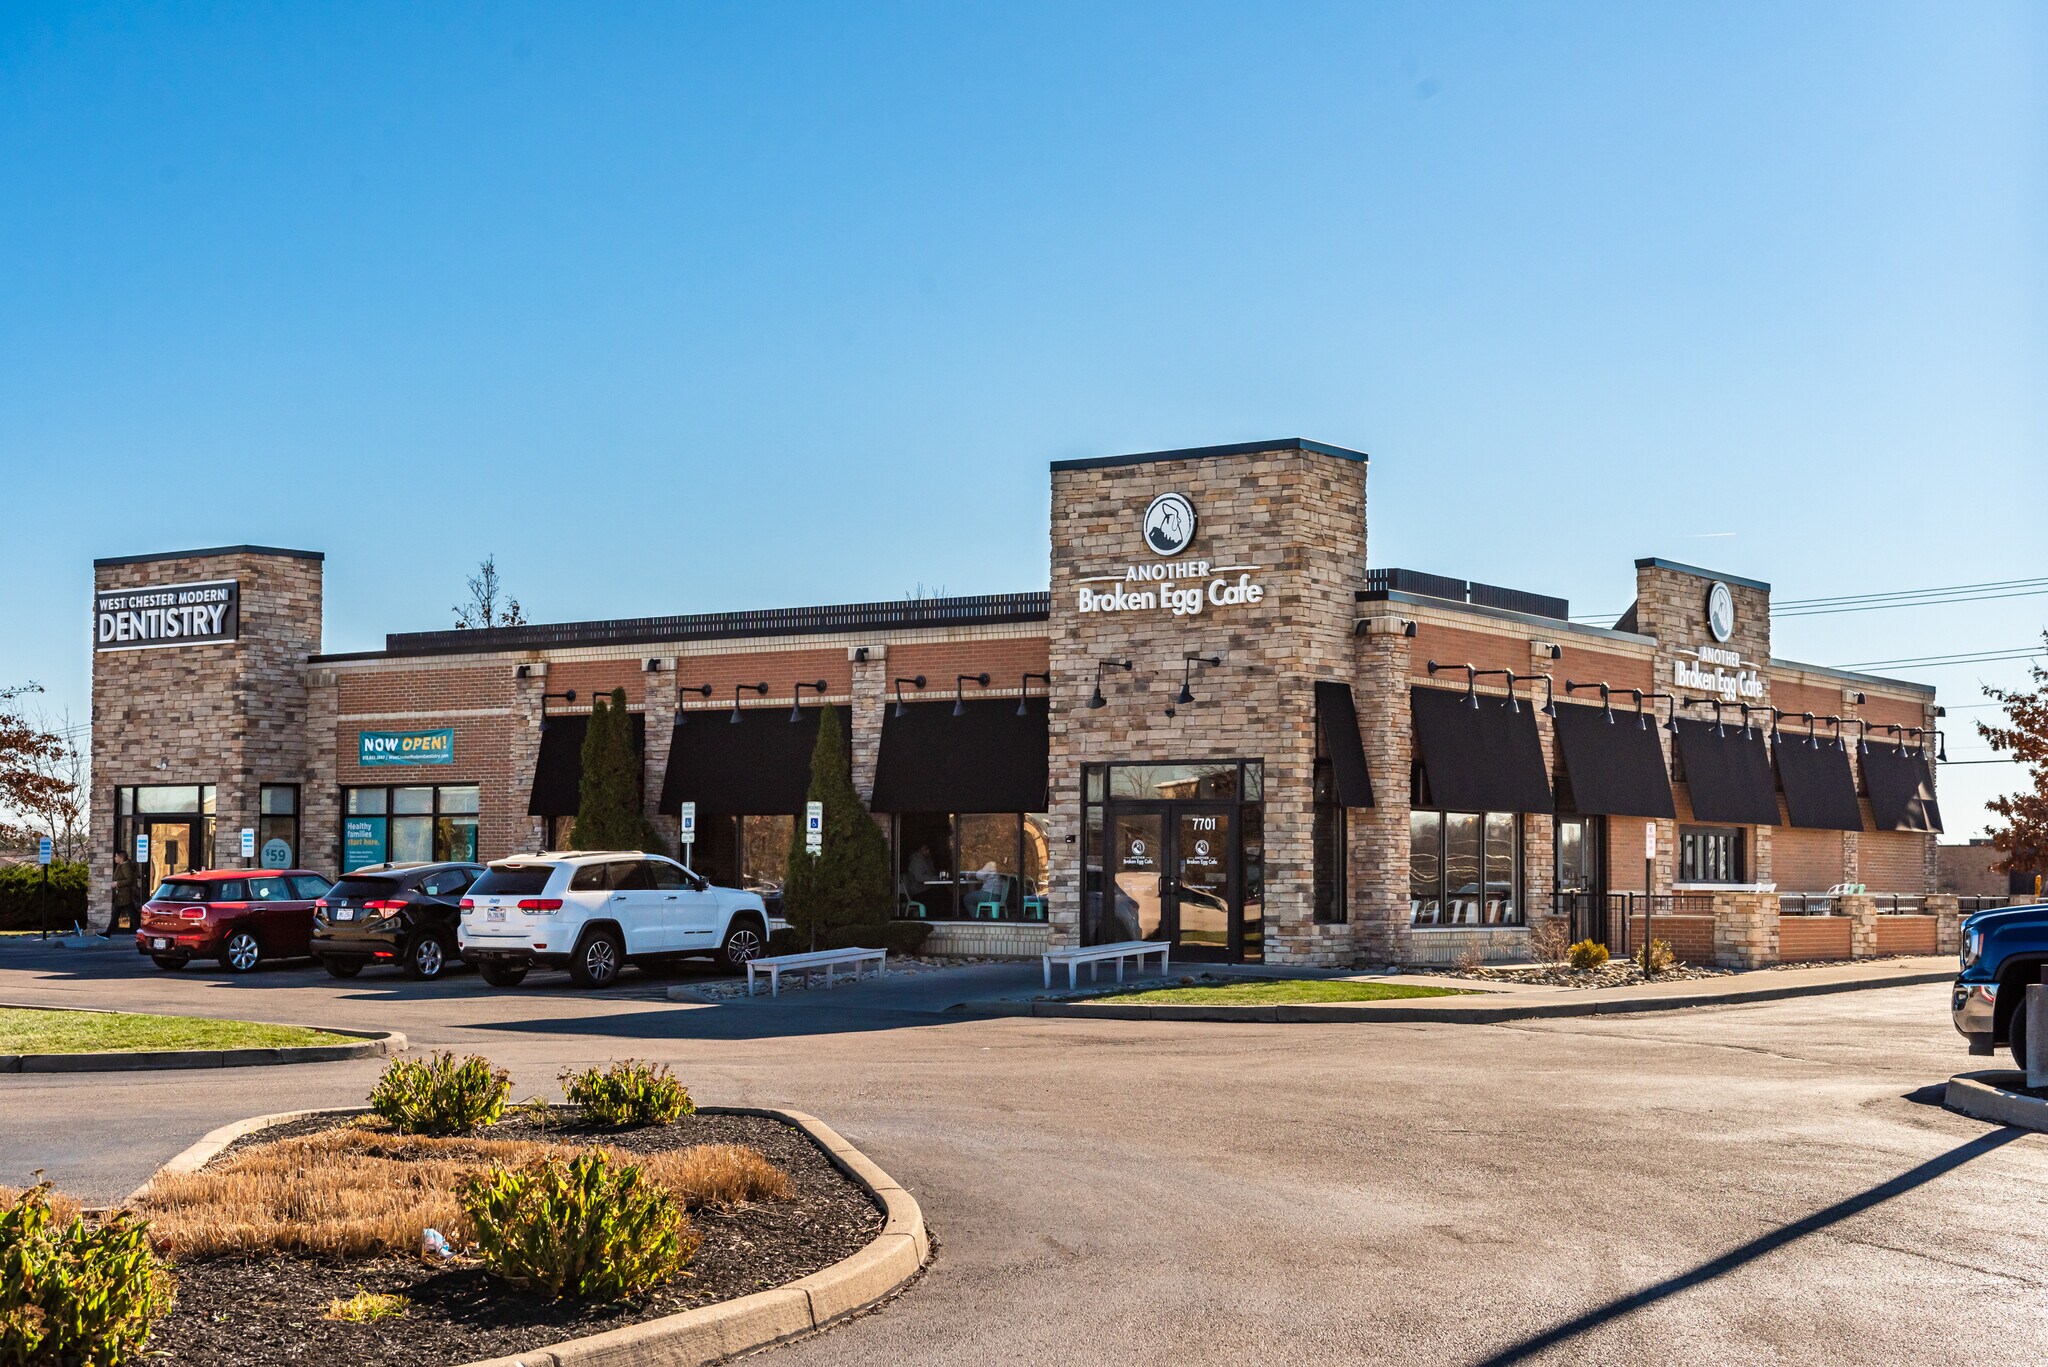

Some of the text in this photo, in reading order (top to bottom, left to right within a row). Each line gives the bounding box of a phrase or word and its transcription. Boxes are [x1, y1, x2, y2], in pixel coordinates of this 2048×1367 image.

[1126, 561, 1210, 582] ANOTHER
[99, 588, 228, 611] WEST CHESTER MODERN
[1079, 573, 1264, 616] Broken Egg Cafe
[99, 604, 228, 642] DENTISTRY
[1698, 646, 1740, 667] ANOTHER
[1674, 660, 1763, 702] Broken Egg Cafe
[364, 735, 447, 752] NOW OPEN!
[347, 822, 372, 831] Healthy
[347, 830, 372, 838] families
[1192, 817, 1216, 831] 7701
[265, 848, 286, 861] $59
